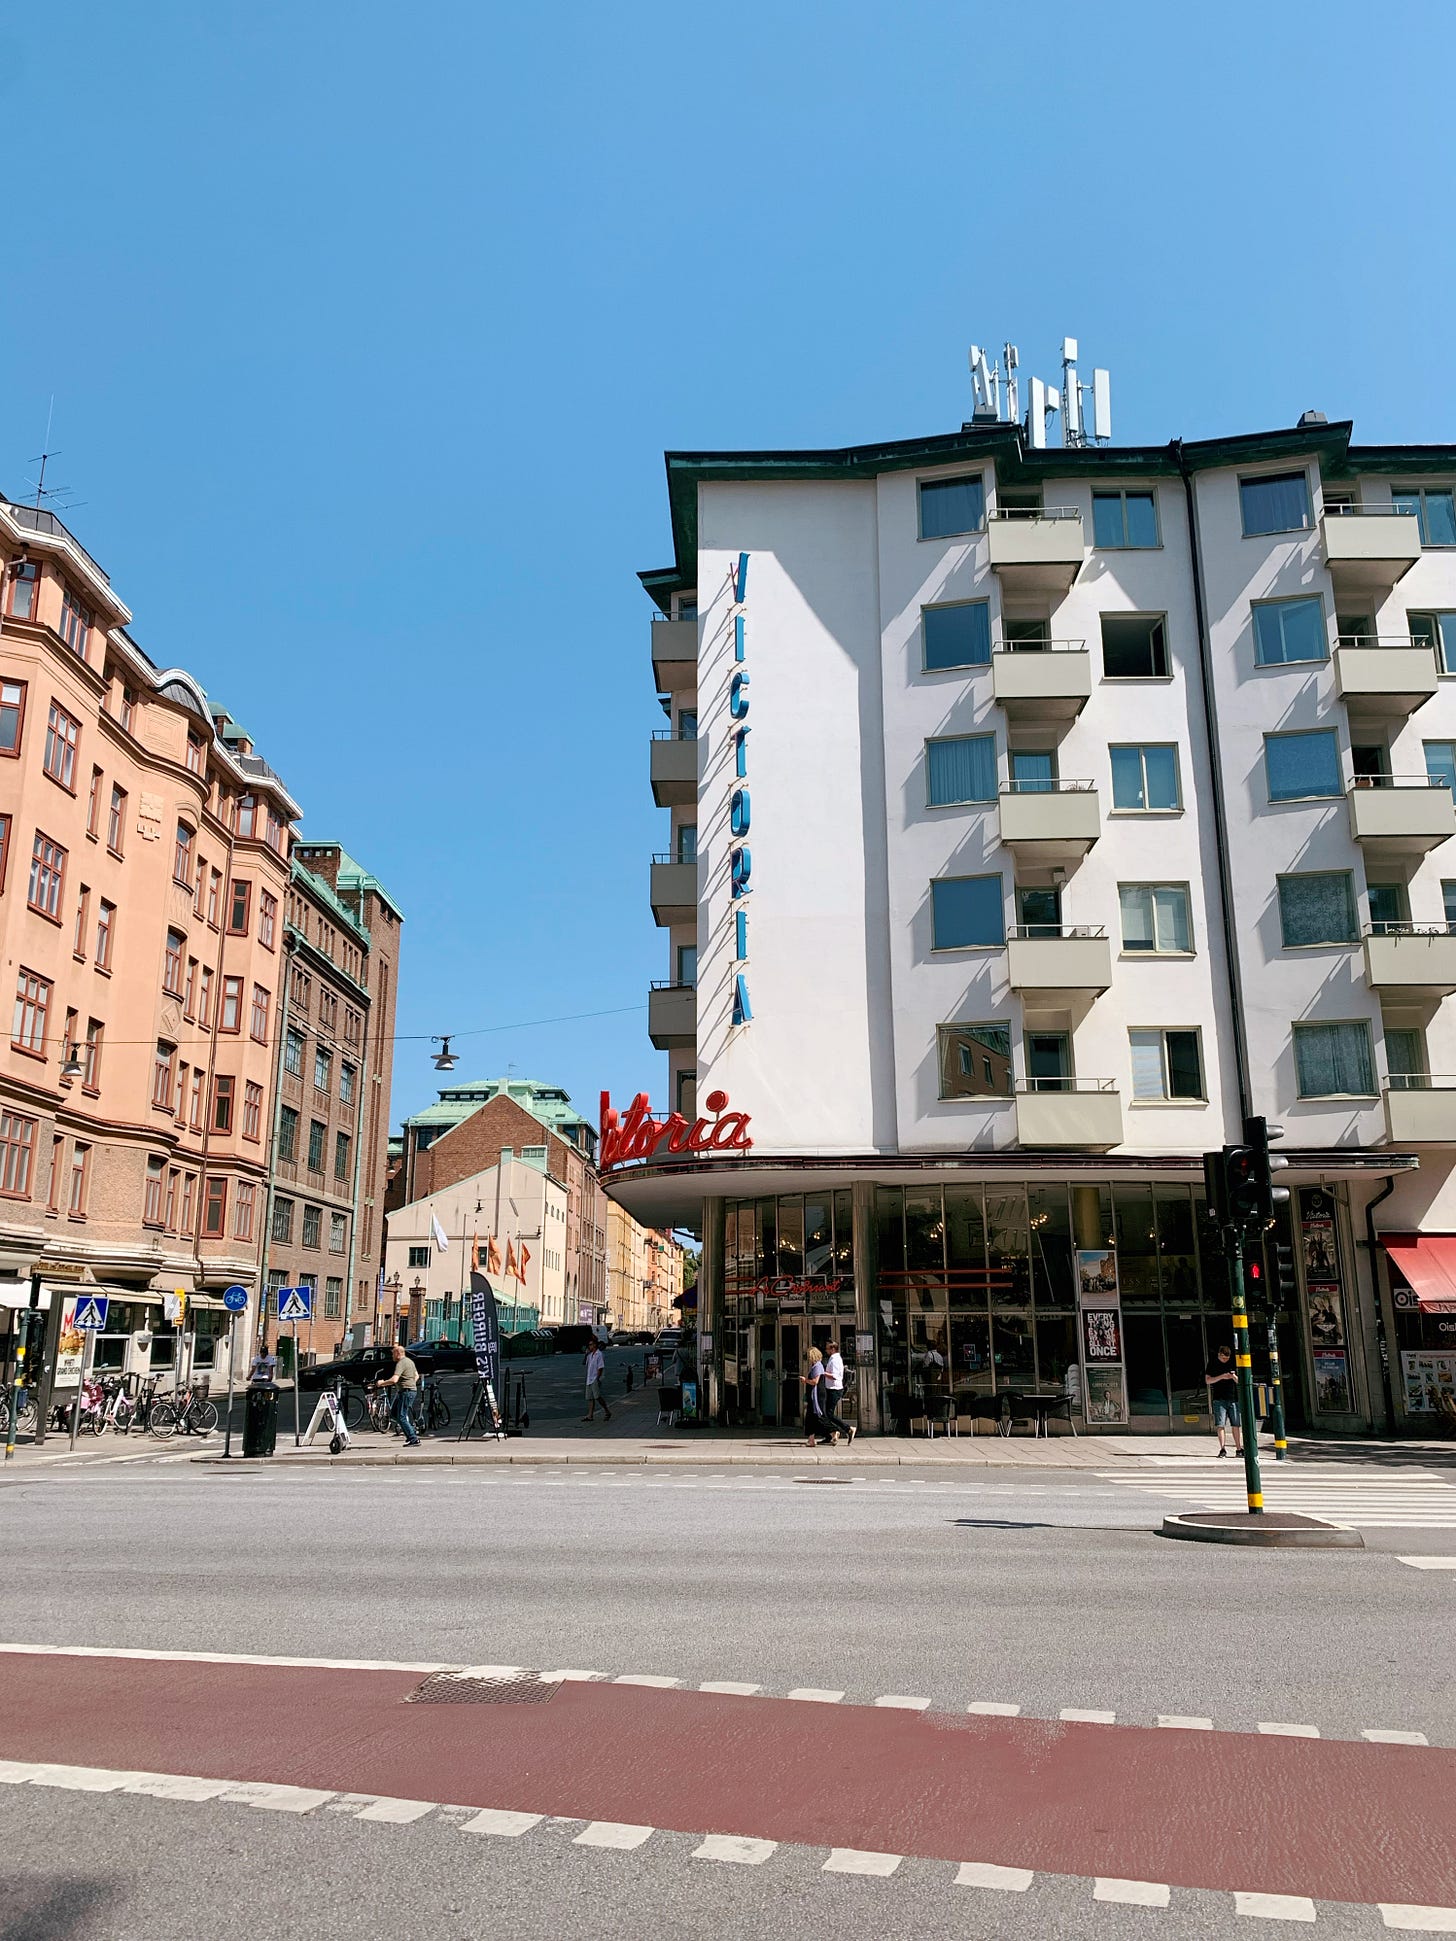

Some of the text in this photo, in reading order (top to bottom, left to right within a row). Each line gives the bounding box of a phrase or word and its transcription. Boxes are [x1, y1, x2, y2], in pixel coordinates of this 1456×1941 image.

[729, 551, 754, 1026] VICTORIA
[600, 1090, 754, 1171] toria
[1087, 1313, 1114, 1321] EVERY
[1088, 1320, 1115, 1329] TNG
[1089, 1346, 1118, 1356] ONCE
